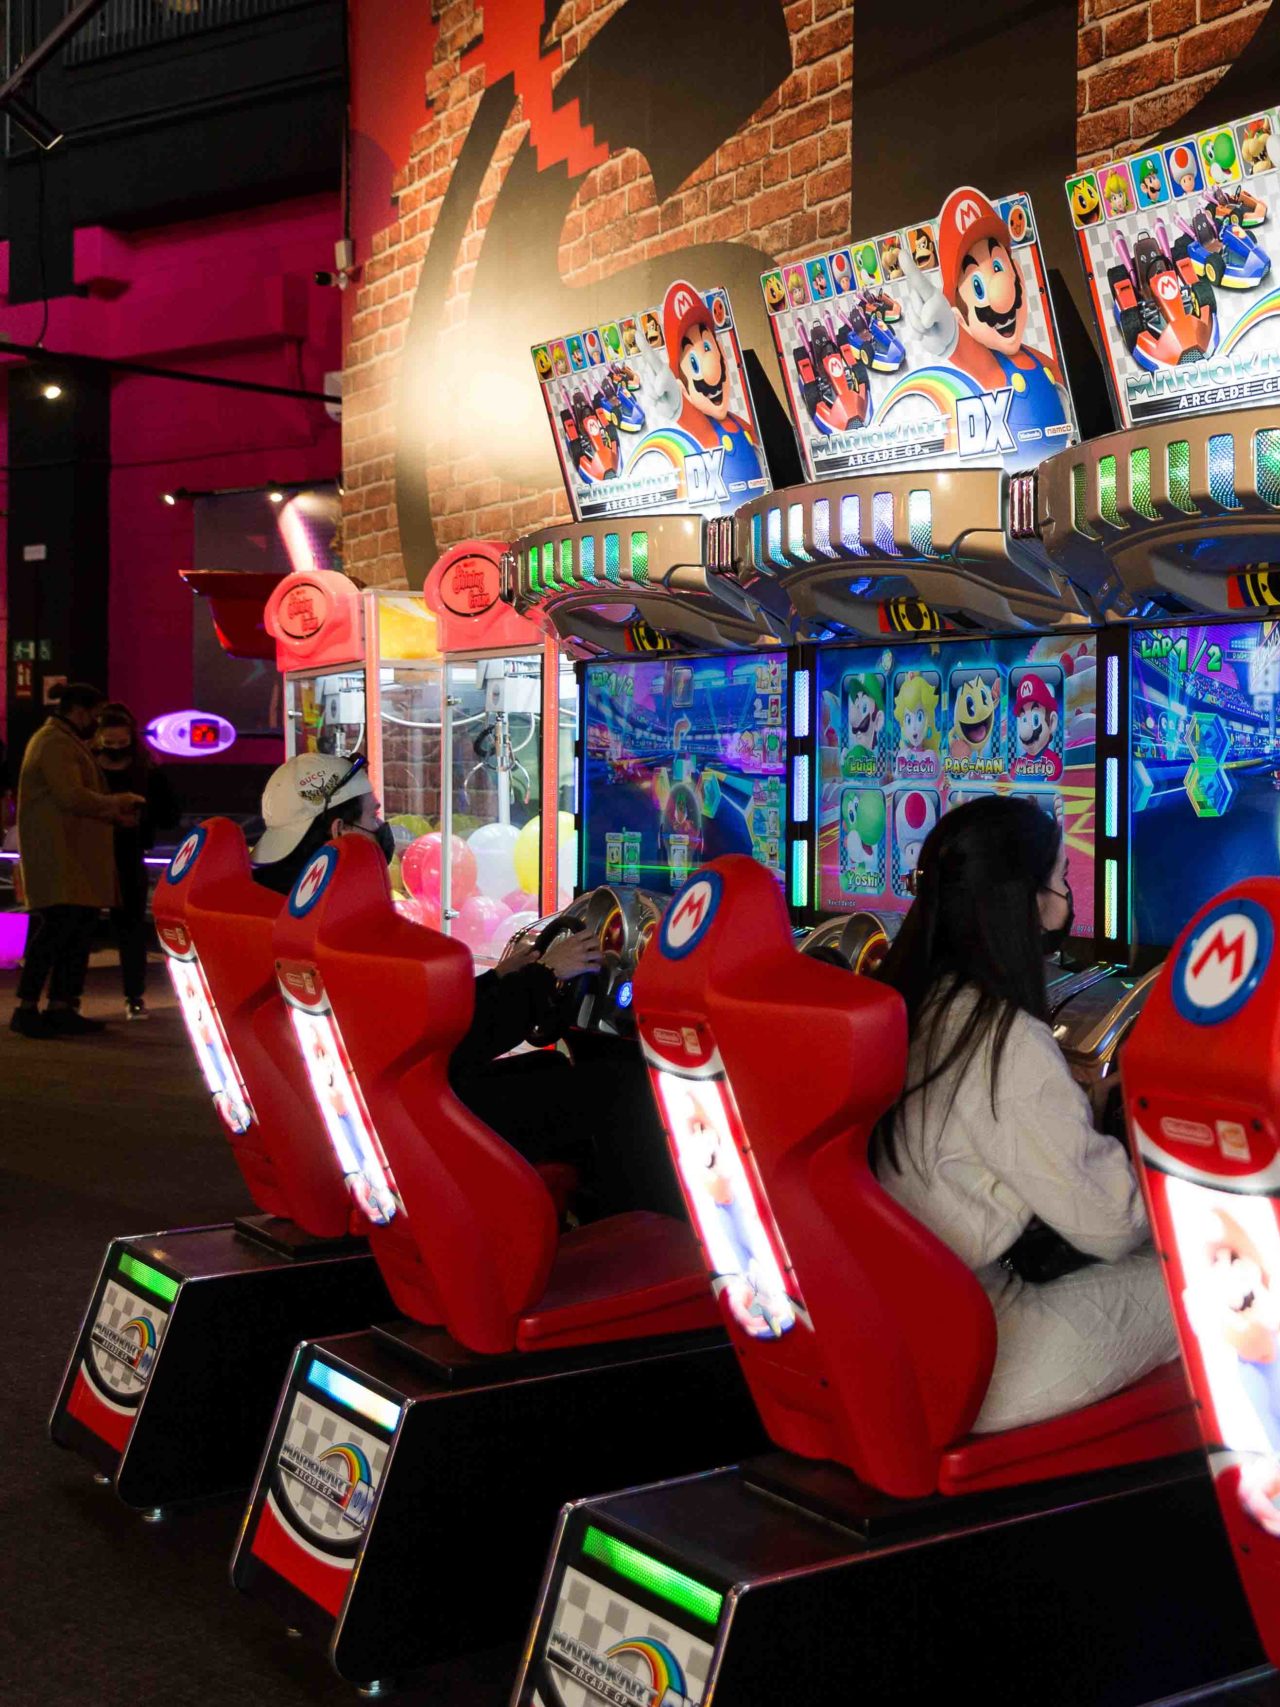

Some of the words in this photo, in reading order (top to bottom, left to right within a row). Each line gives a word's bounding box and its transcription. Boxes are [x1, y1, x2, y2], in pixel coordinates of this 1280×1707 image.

[1178, 386, 1251, 409] ARCADE
[956, 387, 1018, 460] DX
[847, 449, 898, 467] ARCADE
[685, 448, 730, 506] DX
[1141, 636, 1173, 659] LAP
[848, 756, 877, 776] Luigi
[898, 756, 935, 775] Peach
[944, 756, 1006, 776] PAC-MAN
[1015, 756, 1056, 776] Mario
[299, 770, 326, 787] GUCCI
[848, 869, 880, 889] Yoshi
[570, 1663, 611, 1696] ARCADE
